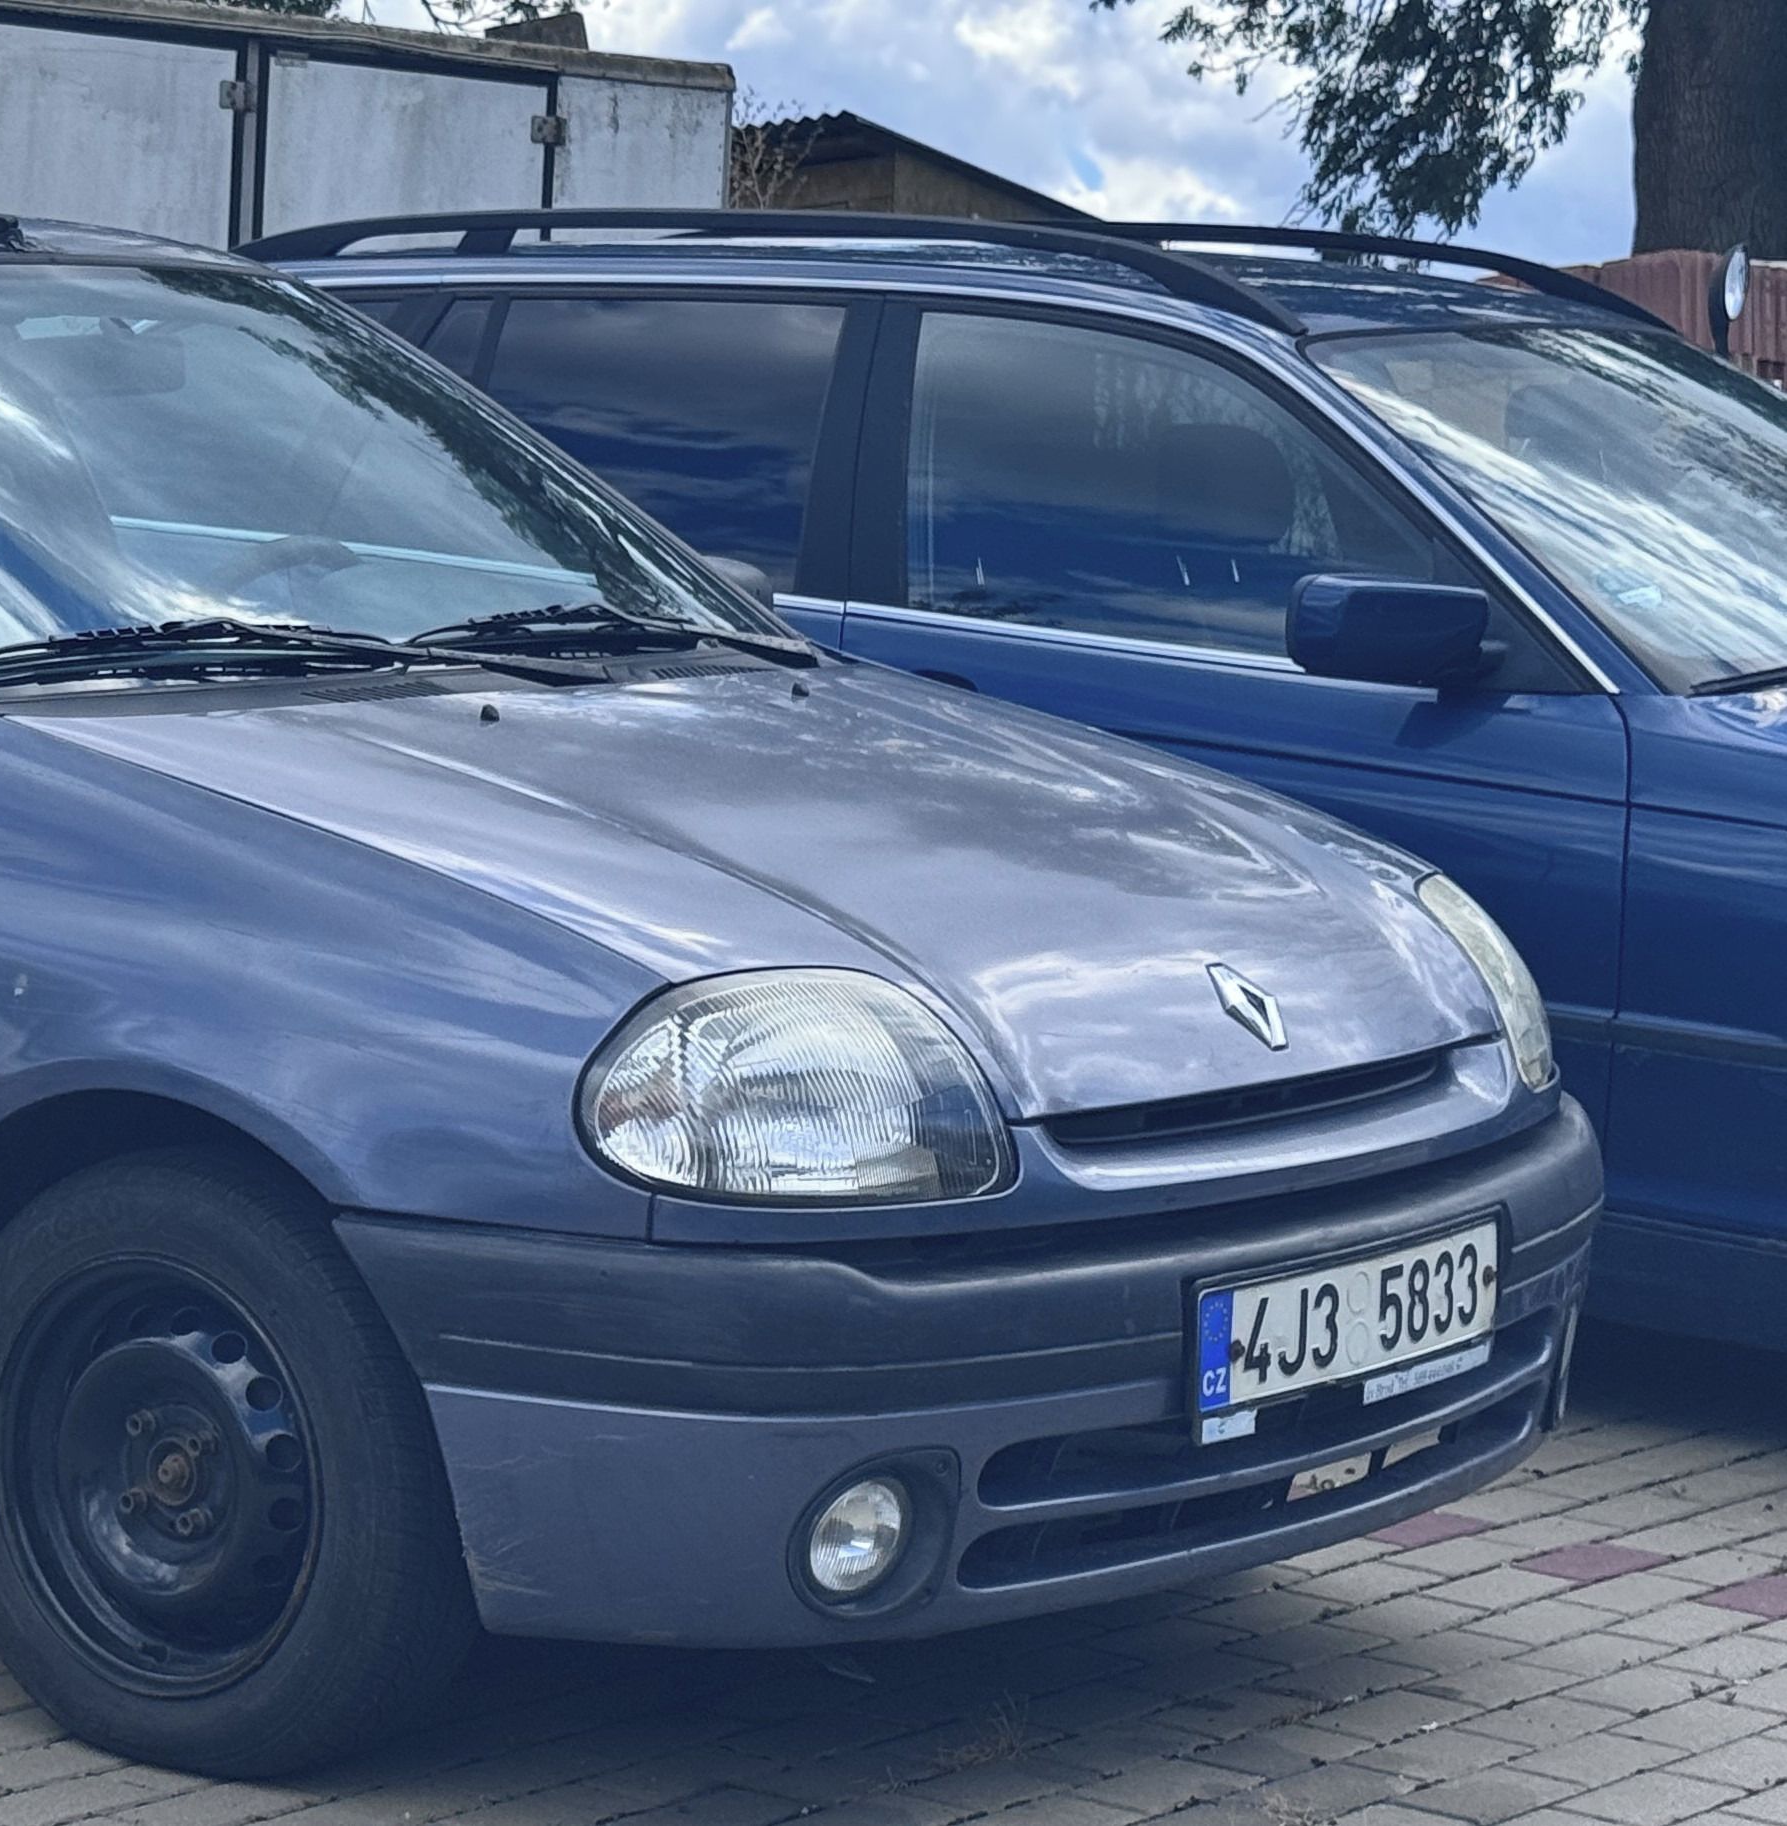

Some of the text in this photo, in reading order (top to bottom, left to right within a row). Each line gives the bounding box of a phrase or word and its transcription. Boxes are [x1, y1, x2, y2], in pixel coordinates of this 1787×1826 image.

[1203, 1243, 1478, 1397] CZ 4J3 5833
